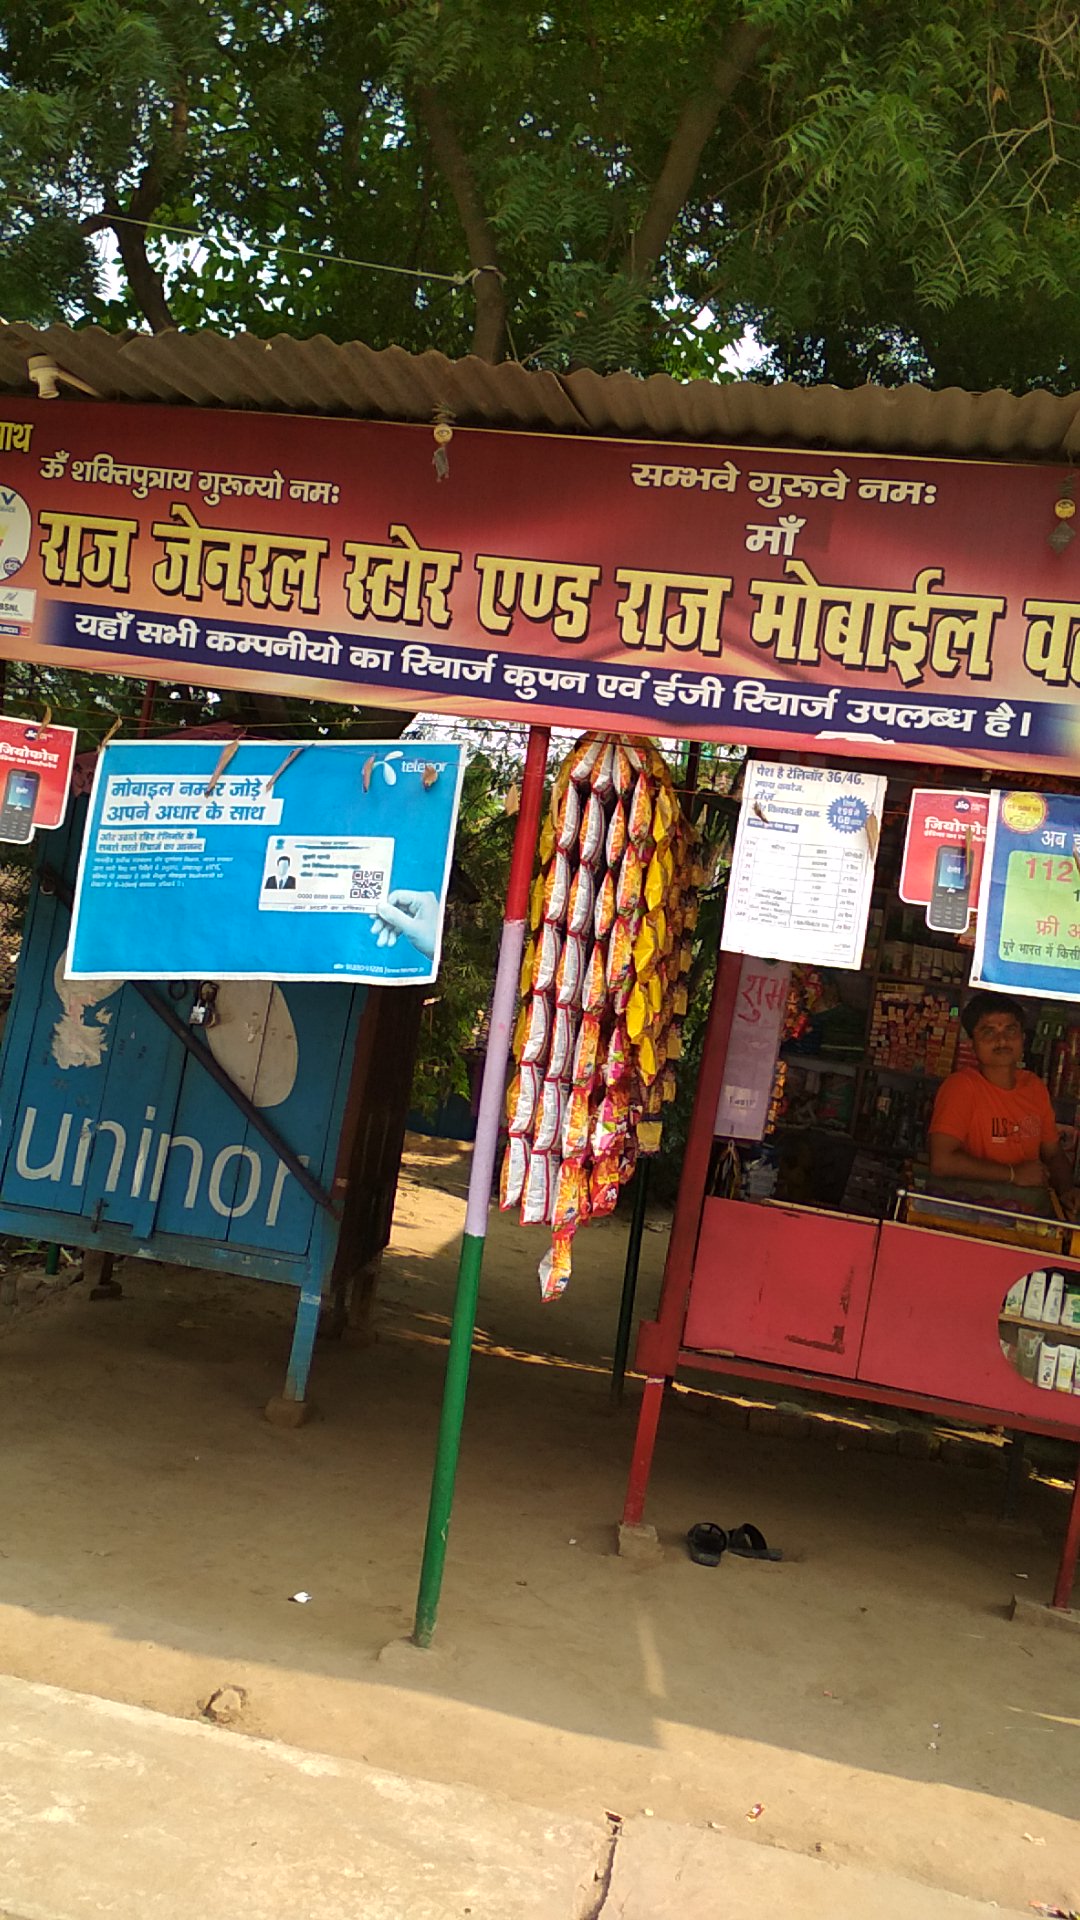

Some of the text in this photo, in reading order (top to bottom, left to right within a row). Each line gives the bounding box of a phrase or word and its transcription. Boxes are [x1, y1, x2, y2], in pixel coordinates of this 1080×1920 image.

[71, 454, 193, 498] शक्तिपुत्राय
[289, 479, 340, 503] नमः
[631, 461, 937, 508] सम्भवे गुरूवे नमः
[745, 514, 806, 556] माँ
[39, 510, 137, 588] राज
[153, 504, 328, 610] जेनरल
[344, 525, 460, 624] स्टोर
[476, 555, 600, 639] एण्ड
[616, 569, 732, 652] राज
[750, 560, 1005, 683] मोबाईल
[75, 611, 135, 640] यहाँ
[136, 619, 200, 649] सभी
[206, 630, 342, 665] कम्पनीयो
[349, 646, 394, 672] का
[401, 644, 498, 683] रिचार्ज
[503, 664, 590, 700] कुपन
[597, 671, 651, 700] एवं
[653, 674, 725, 708] ईजी
[733, 680, 840, 720] रिचार्ज
[847, 699, 977, 732] उपलब्ध
[787, 765, 824, 782] टेलिनॉर
[111, 778, 175, 799] मोबाइल
[229, 778, 262, 800] जोड़े
[107, 801, 266, 821] अपने अधार के साथ
[955, 801, 969, 810] Jio
[1041, 830, 1067, 849] अब
[1036, 915, 1060, 937] फ्री
[1019, 943, 1041, 957] भारत
[16, 1105, 310, 1227] uninor
